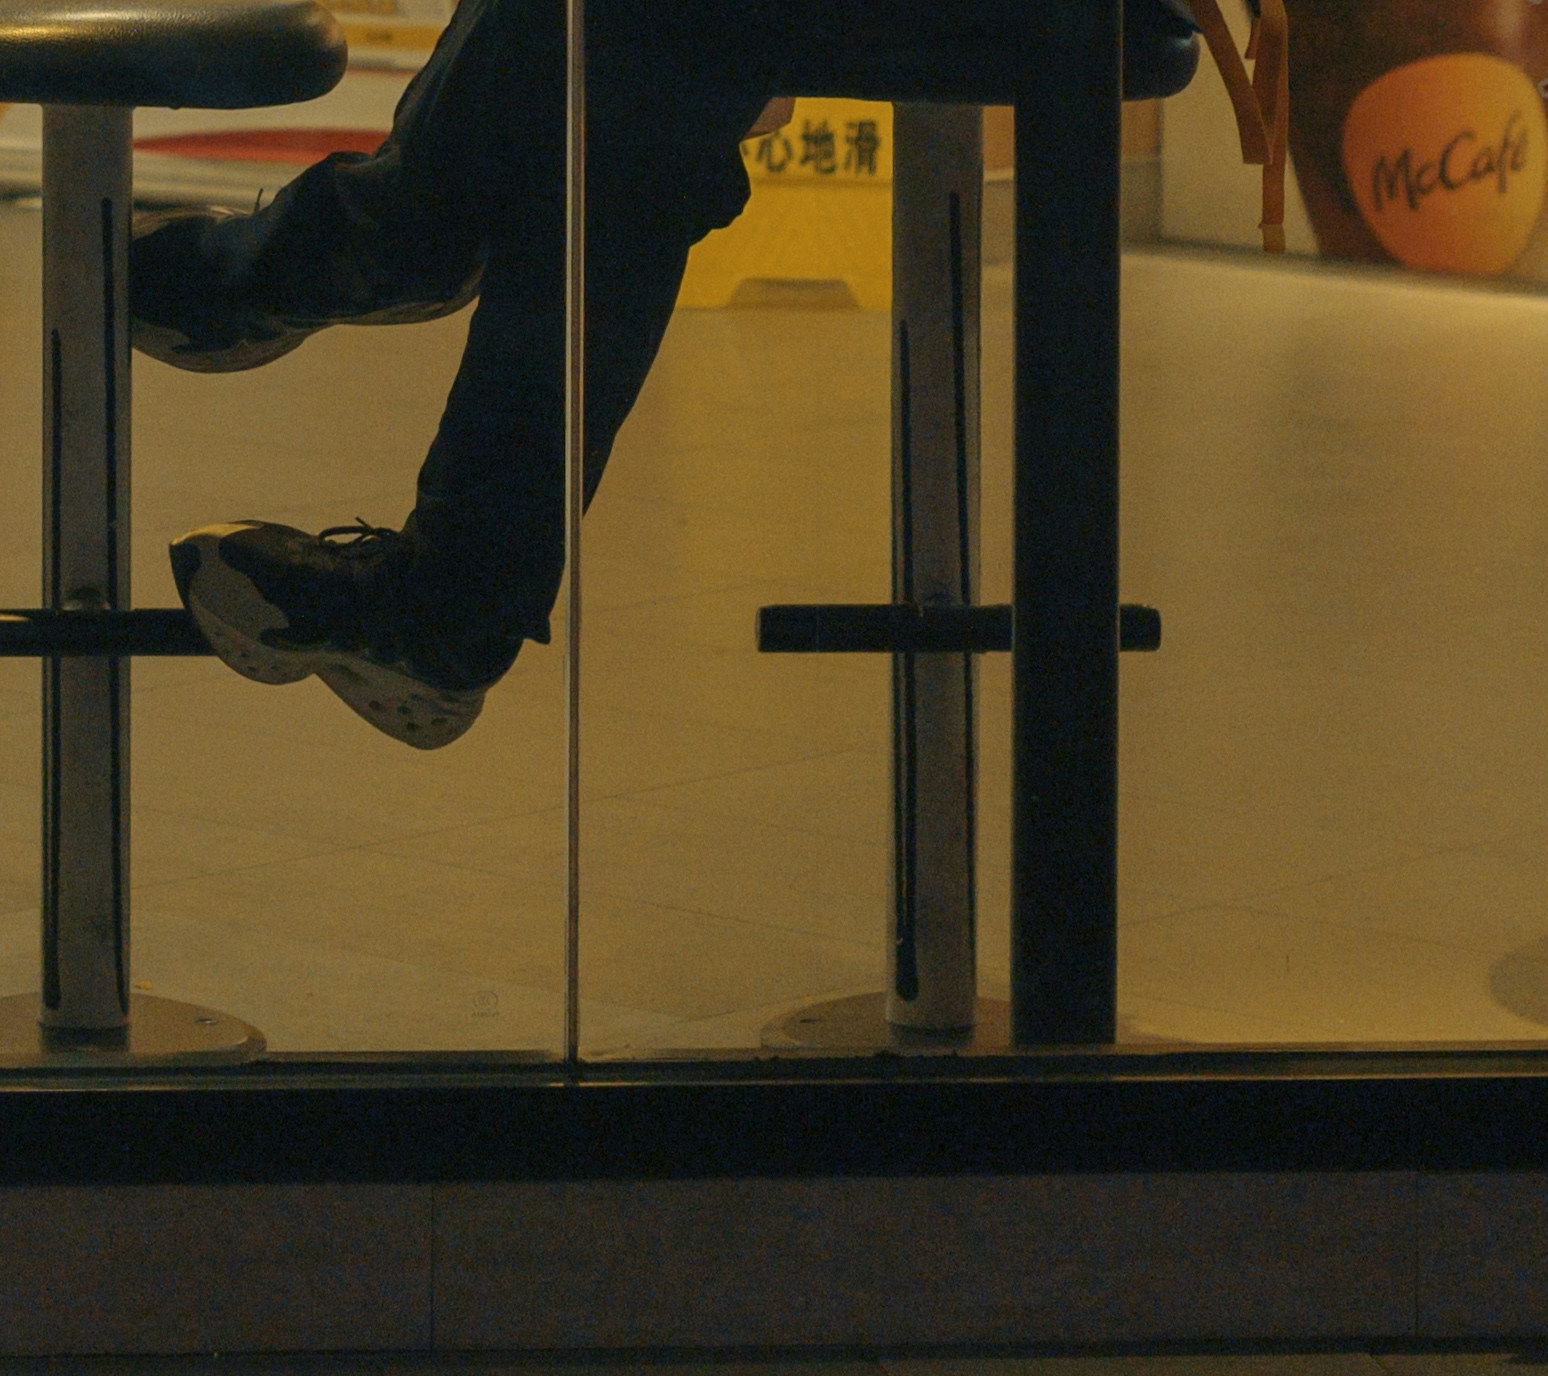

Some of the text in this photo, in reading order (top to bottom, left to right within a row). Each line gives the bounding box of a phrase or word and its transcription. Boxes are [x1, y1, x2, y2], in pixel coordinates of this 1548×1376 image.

[740, 118, 882, 177] 心地滑
[1370, 108, 1530, 214] McCafé
